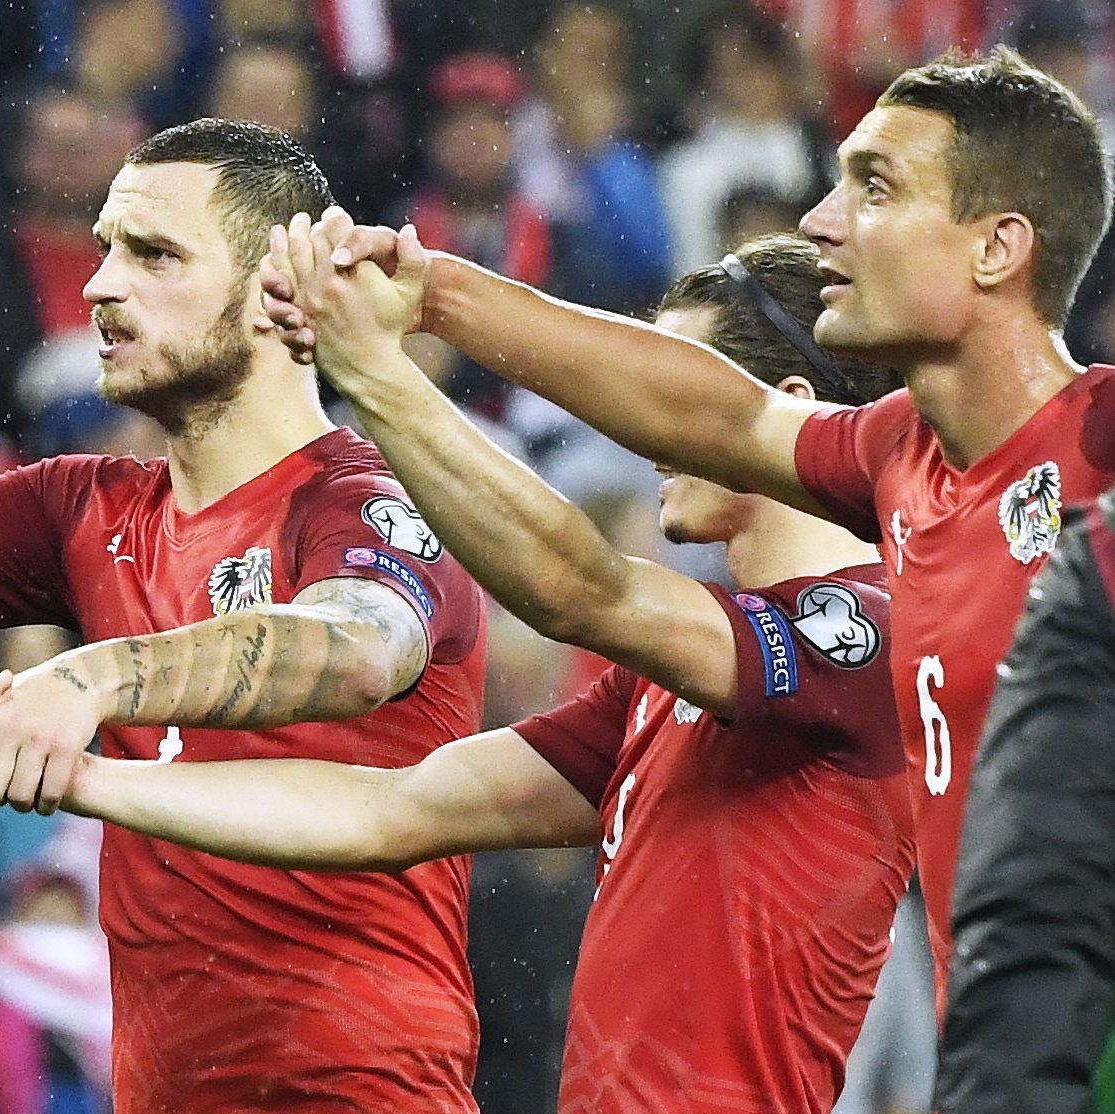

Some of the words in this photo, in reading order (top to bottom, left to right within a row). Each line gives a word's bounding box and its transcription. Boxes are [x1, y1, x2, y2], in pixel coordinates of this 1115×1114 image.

[378, 555, 434, 620] RESPECT
[755, 612, 790, 695] RESPECT
[915, 655, 951, 796] 6
